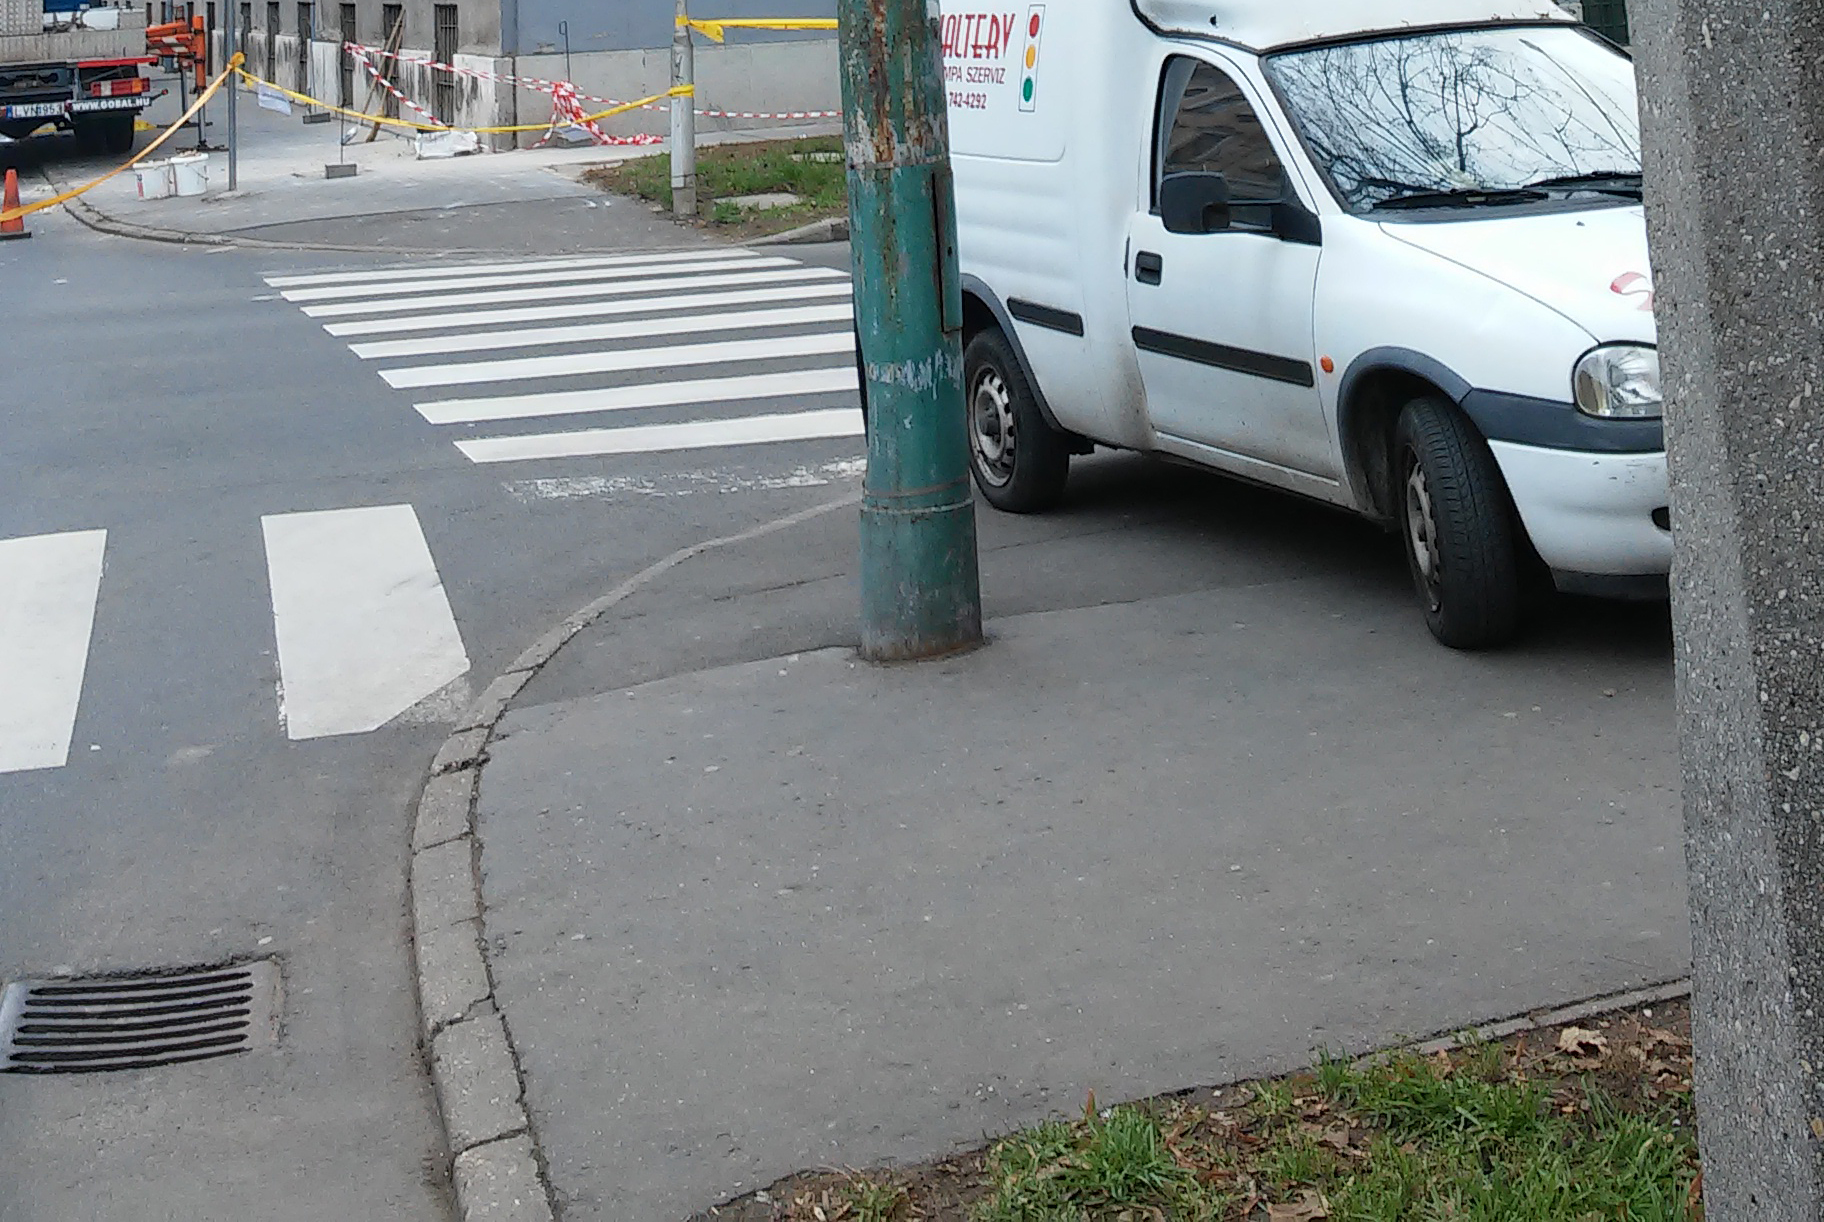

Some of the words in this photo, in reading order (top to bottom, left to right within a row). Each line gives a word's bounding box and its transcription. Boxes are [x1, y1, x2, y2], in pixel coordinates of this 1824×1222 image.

[943, 65, 963, 83] MPA
[966, 66, 1006, 85] SZERVIZ
[72, 97, 150, 111] WWW.GOBAL.HU
